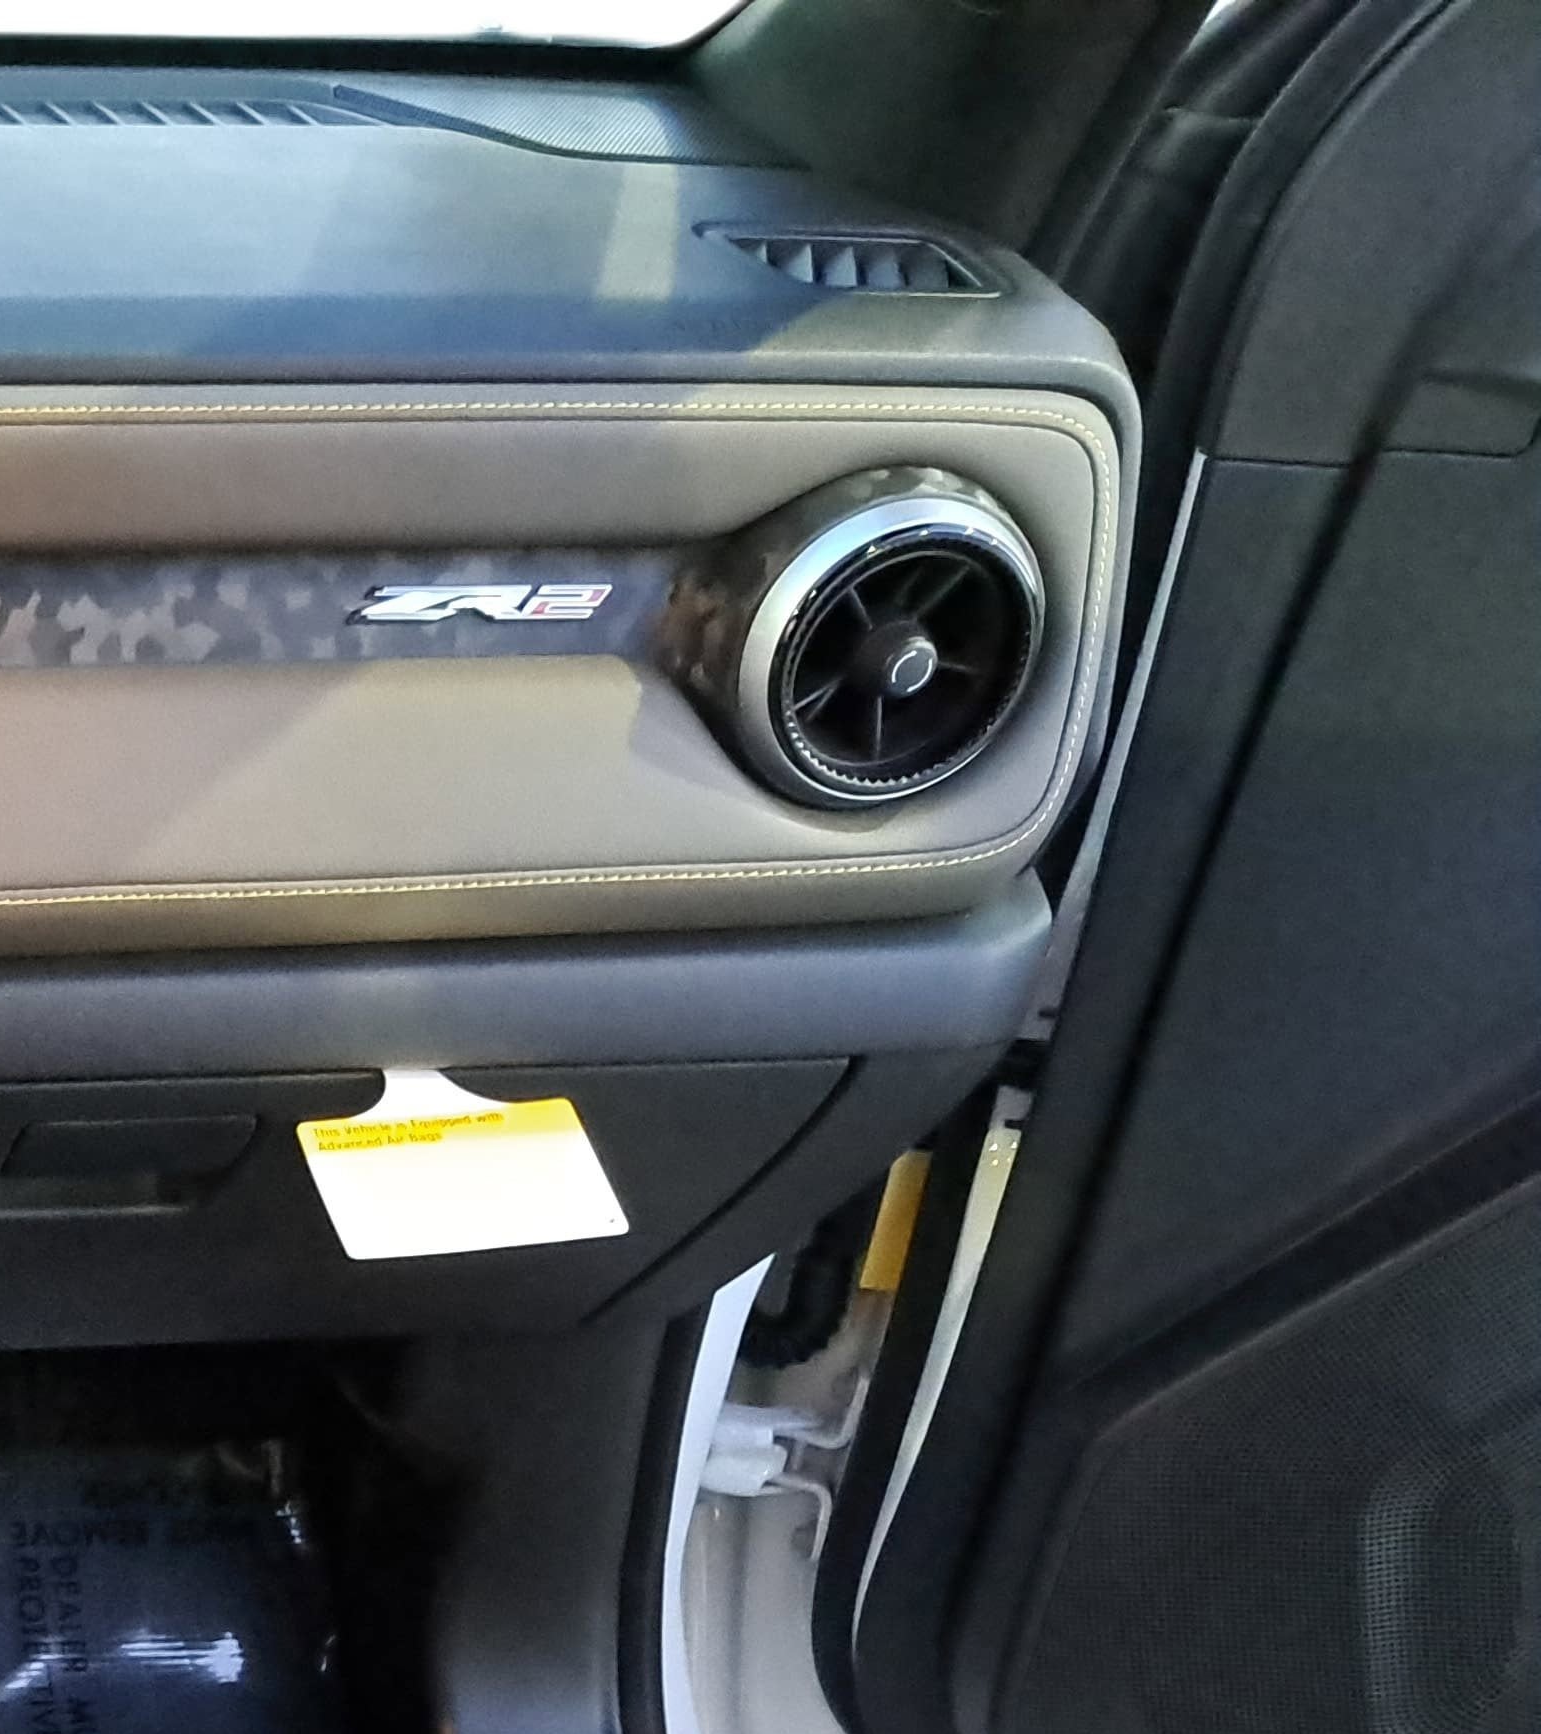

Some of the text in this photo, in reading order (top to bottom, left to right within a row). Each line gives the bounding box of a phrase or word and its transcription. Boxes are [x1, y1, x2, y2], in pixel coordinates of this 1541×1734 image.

[313, 1127, 340, 1138] This
[346, 1122, 392, 1136] Vehicle
[410, 1115, 473, 1131] Equipped
[477, 1111, 505, 1124] with
[317, 1132, 444, 1152] Advanced Air Bags
[51, 1556, 88, 1673] DEALER
